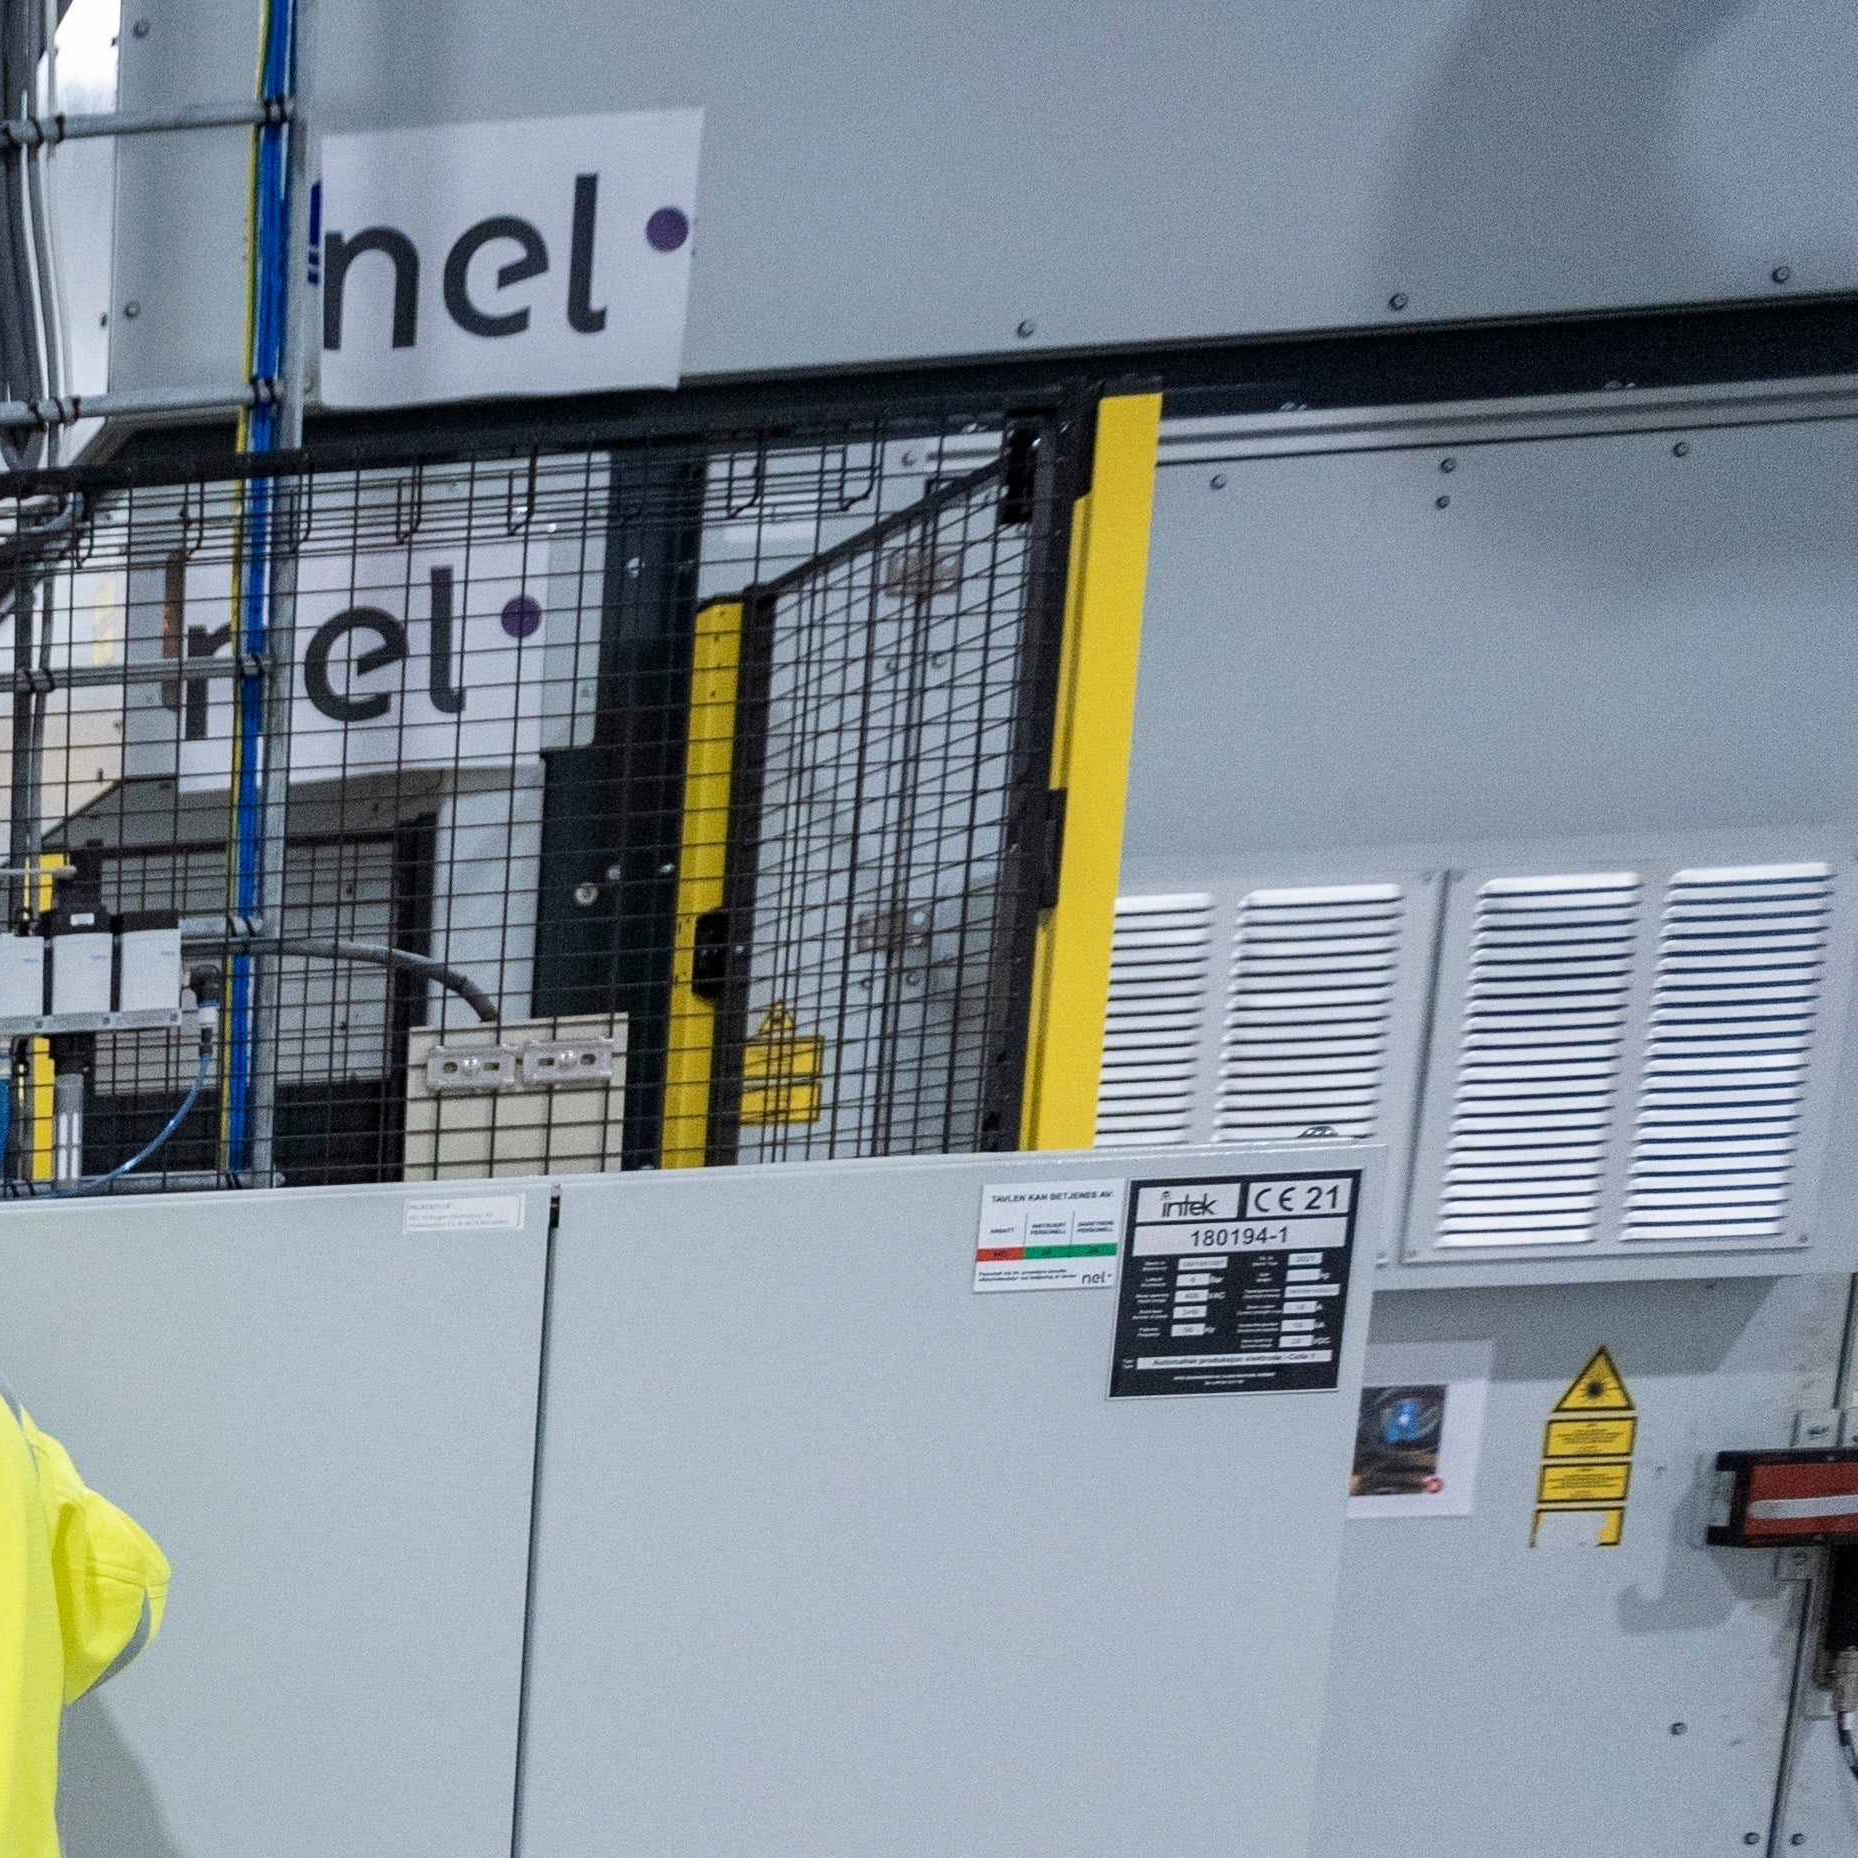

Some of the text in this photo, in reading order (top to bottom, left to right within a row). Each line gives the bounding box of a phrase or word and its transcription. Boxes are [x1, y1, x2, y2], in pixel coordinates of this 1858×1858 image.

[322, 171, 609, 352] nel
[1160, 1191, 1218, 1218] intek
[1304, 1185, 1340, 1211] 21
[1190, 1226, 1289, 1247] 180194-1
[1081, 1271, 1106, 1285] nel
